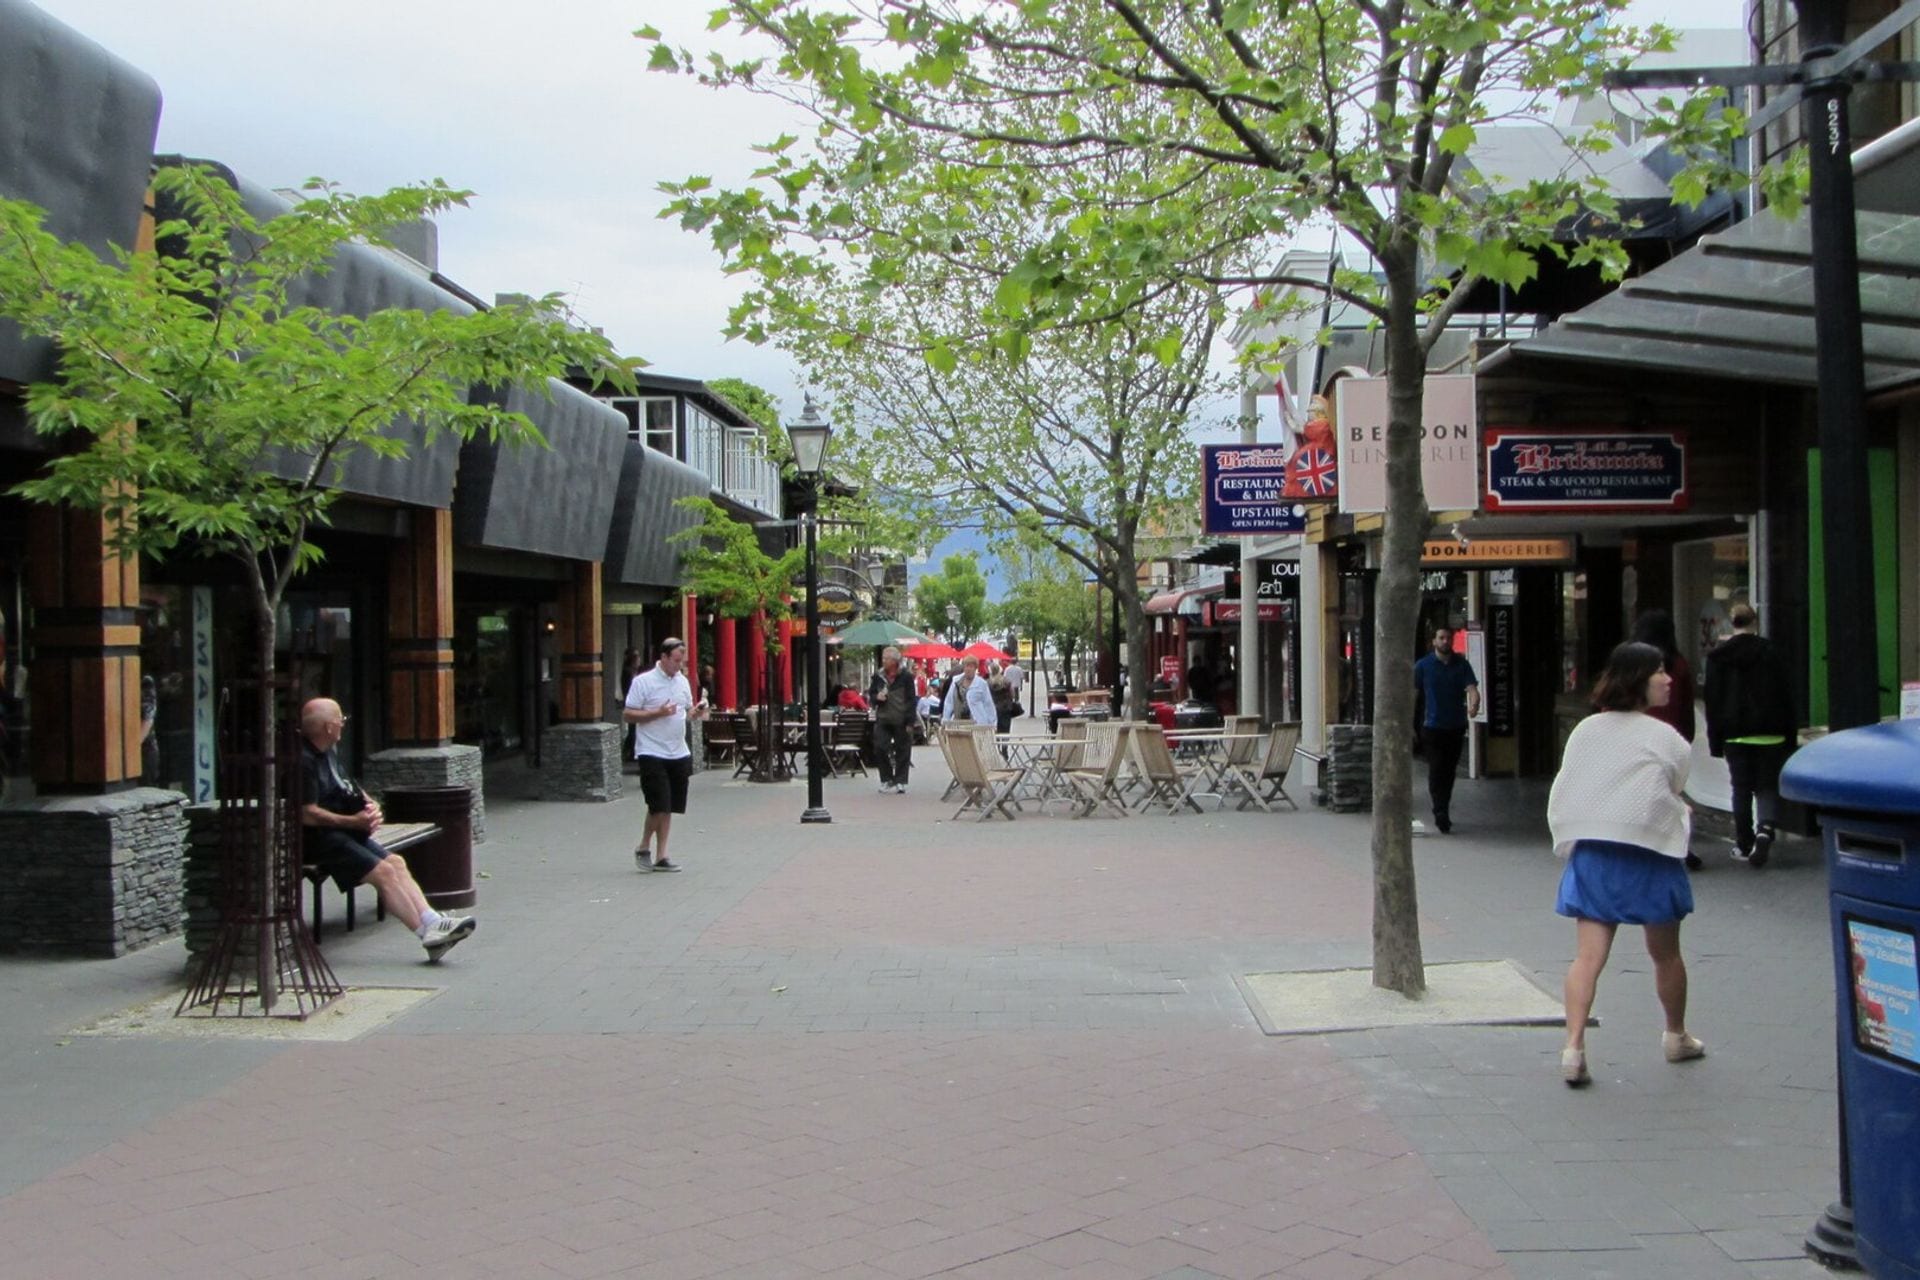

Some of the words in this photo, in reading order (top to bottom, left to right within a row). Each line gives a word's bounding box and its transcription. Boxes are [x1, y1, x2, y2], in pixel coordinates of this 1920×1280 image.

[1827, 99, 1839, 155] 6237
[1351, 446, 1469, 464] LINRIE
[1500, 476, 1535, 487] STEAK
[1537, 477, 1546, 487] &
[1550, 476, 1600, 487] SEAFOOD
[1601, 475, 1673, 486] RESTAURANT
[1242, 491, 1252, 500] &
[1255, 490, 1278, 500] BAR
[1565, 488, 1609, 498] UPSTAIRS
[1232, 507, 1289, 518] UPSTAIRS
[1232, 519, 1251, 528] OPEN
[1253, 519, 1275, 527] FROM
[1472, 543, 1555, 556] LINGERIE
[1496, 610, 1508, 676] STYLISTS
[1496, 683, 1507, 719] HAIR
[1858, 975, 1918, 999] International
[1888, 996, 1909, 1015] Only
